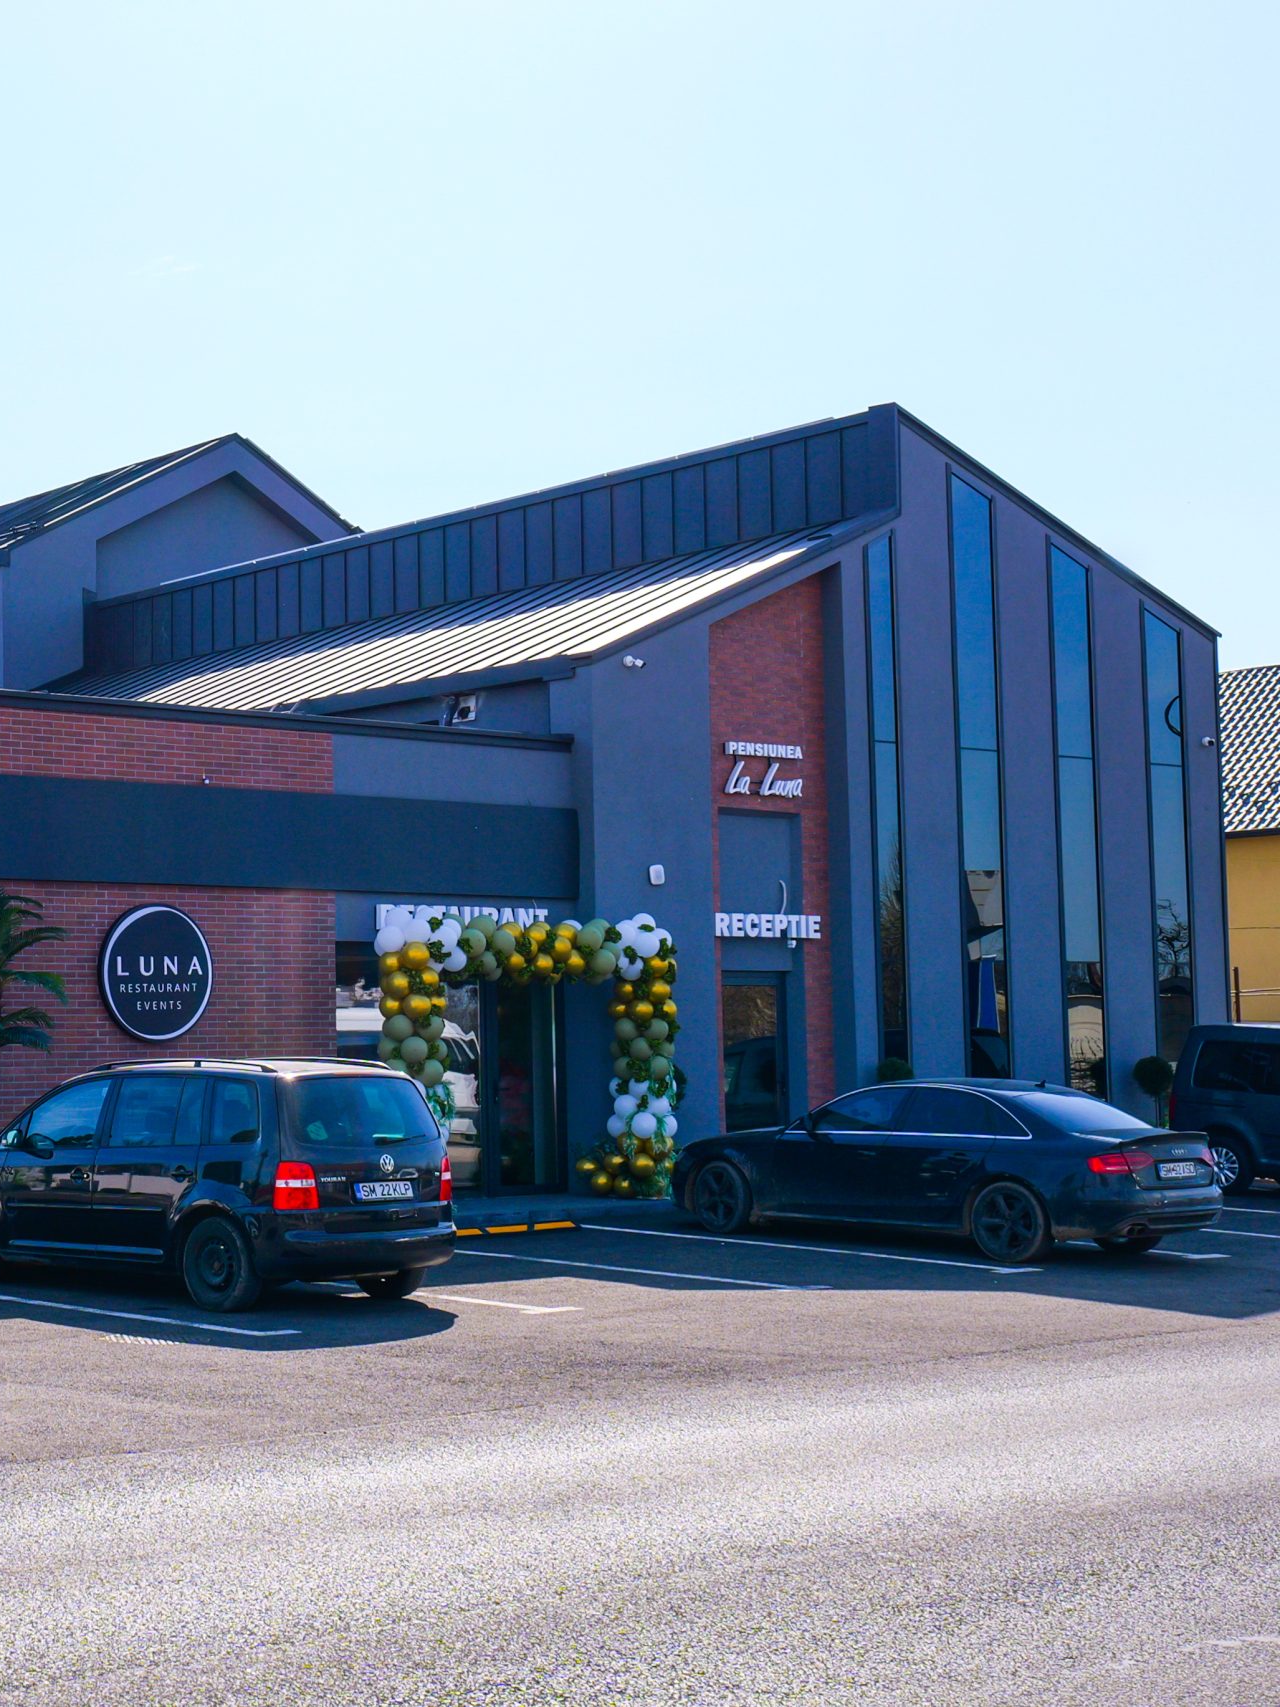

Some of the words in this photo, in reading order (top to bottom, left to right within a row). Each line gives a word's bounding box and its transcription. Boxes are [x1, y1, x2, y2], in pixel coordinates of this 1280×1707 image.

[725, 741, 803, 759] PENSIUNEA
[724, 760, 751, 795] La
[760, 762, 803, 798] Luna
[116, 955, 203, 976] LUNA
[119, 983, 197, 993] RESTAURANT
[136, 1001, 182, 1011] EVENTS
[361, 1185, 378, 1197] SM
